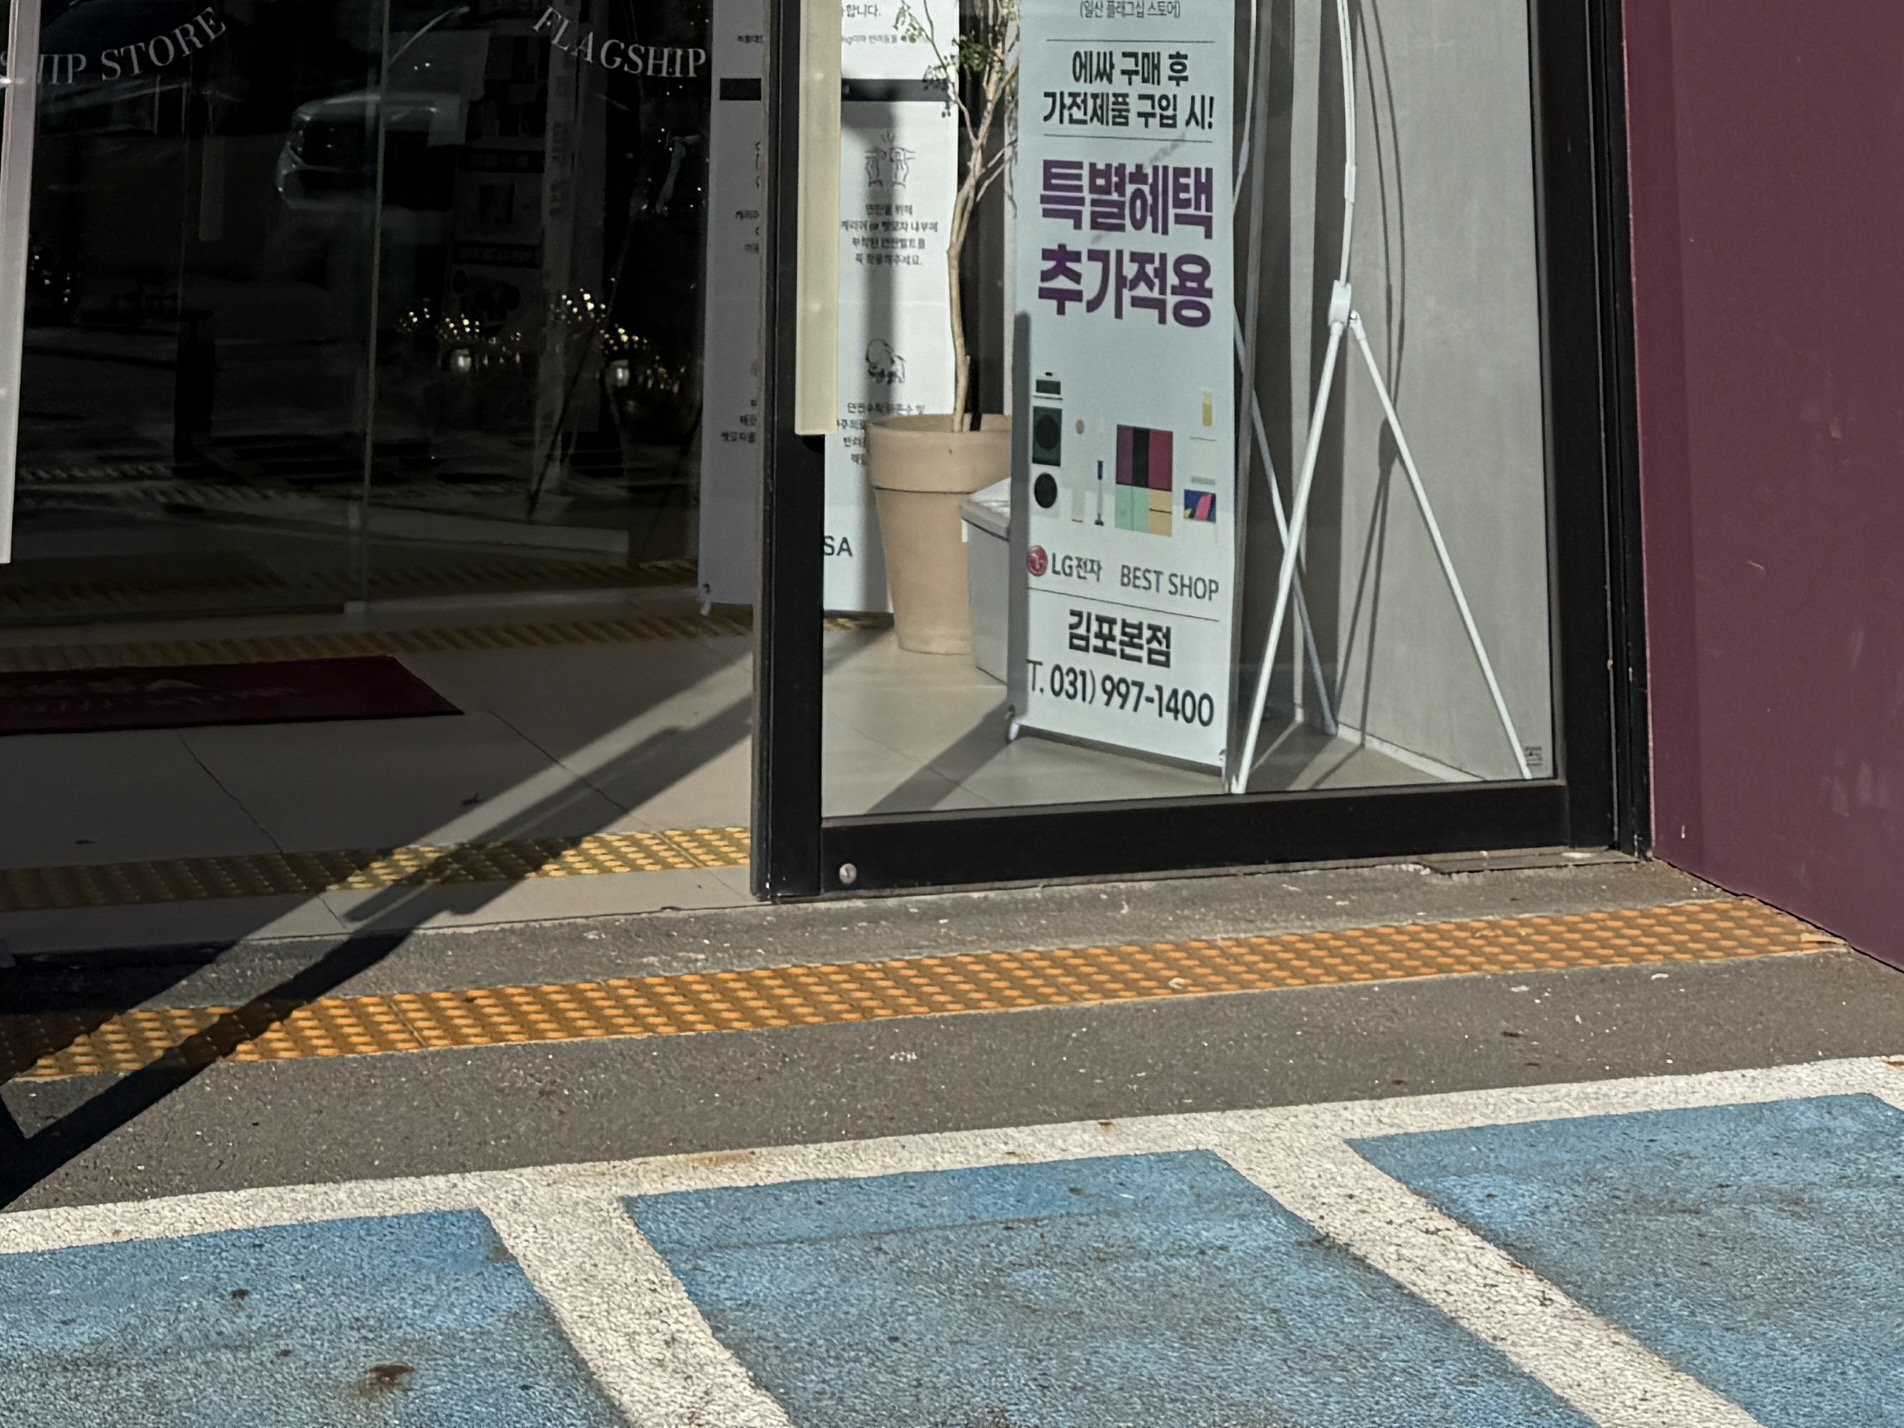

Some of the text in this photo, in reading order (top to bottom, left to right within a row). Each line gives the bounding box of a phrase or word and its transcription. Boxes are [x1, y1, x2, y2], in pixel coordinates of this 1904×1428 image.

[843, 4, 881, 18] 합니다.
[100, 7, 227, 81] STORE
[531, 6, 707, 78] FLAGSHIP
[1072, 50, 1189, 87] 에싸 구매 후
[1043, 91, 1214, 130] 가전제품 구입 시!
[1040, 159, 1213, 240] 특별혜택
[1038, 244, 1213, 327] 추가적용
[823, 535, 853, 557] SA
[1051, 552, 1219, 601] LG전자 BEST SHOP
[1069, 609, 1171, 668] 김포본점
[1026, 659, 1214, 727] T. 031) 997-1400
